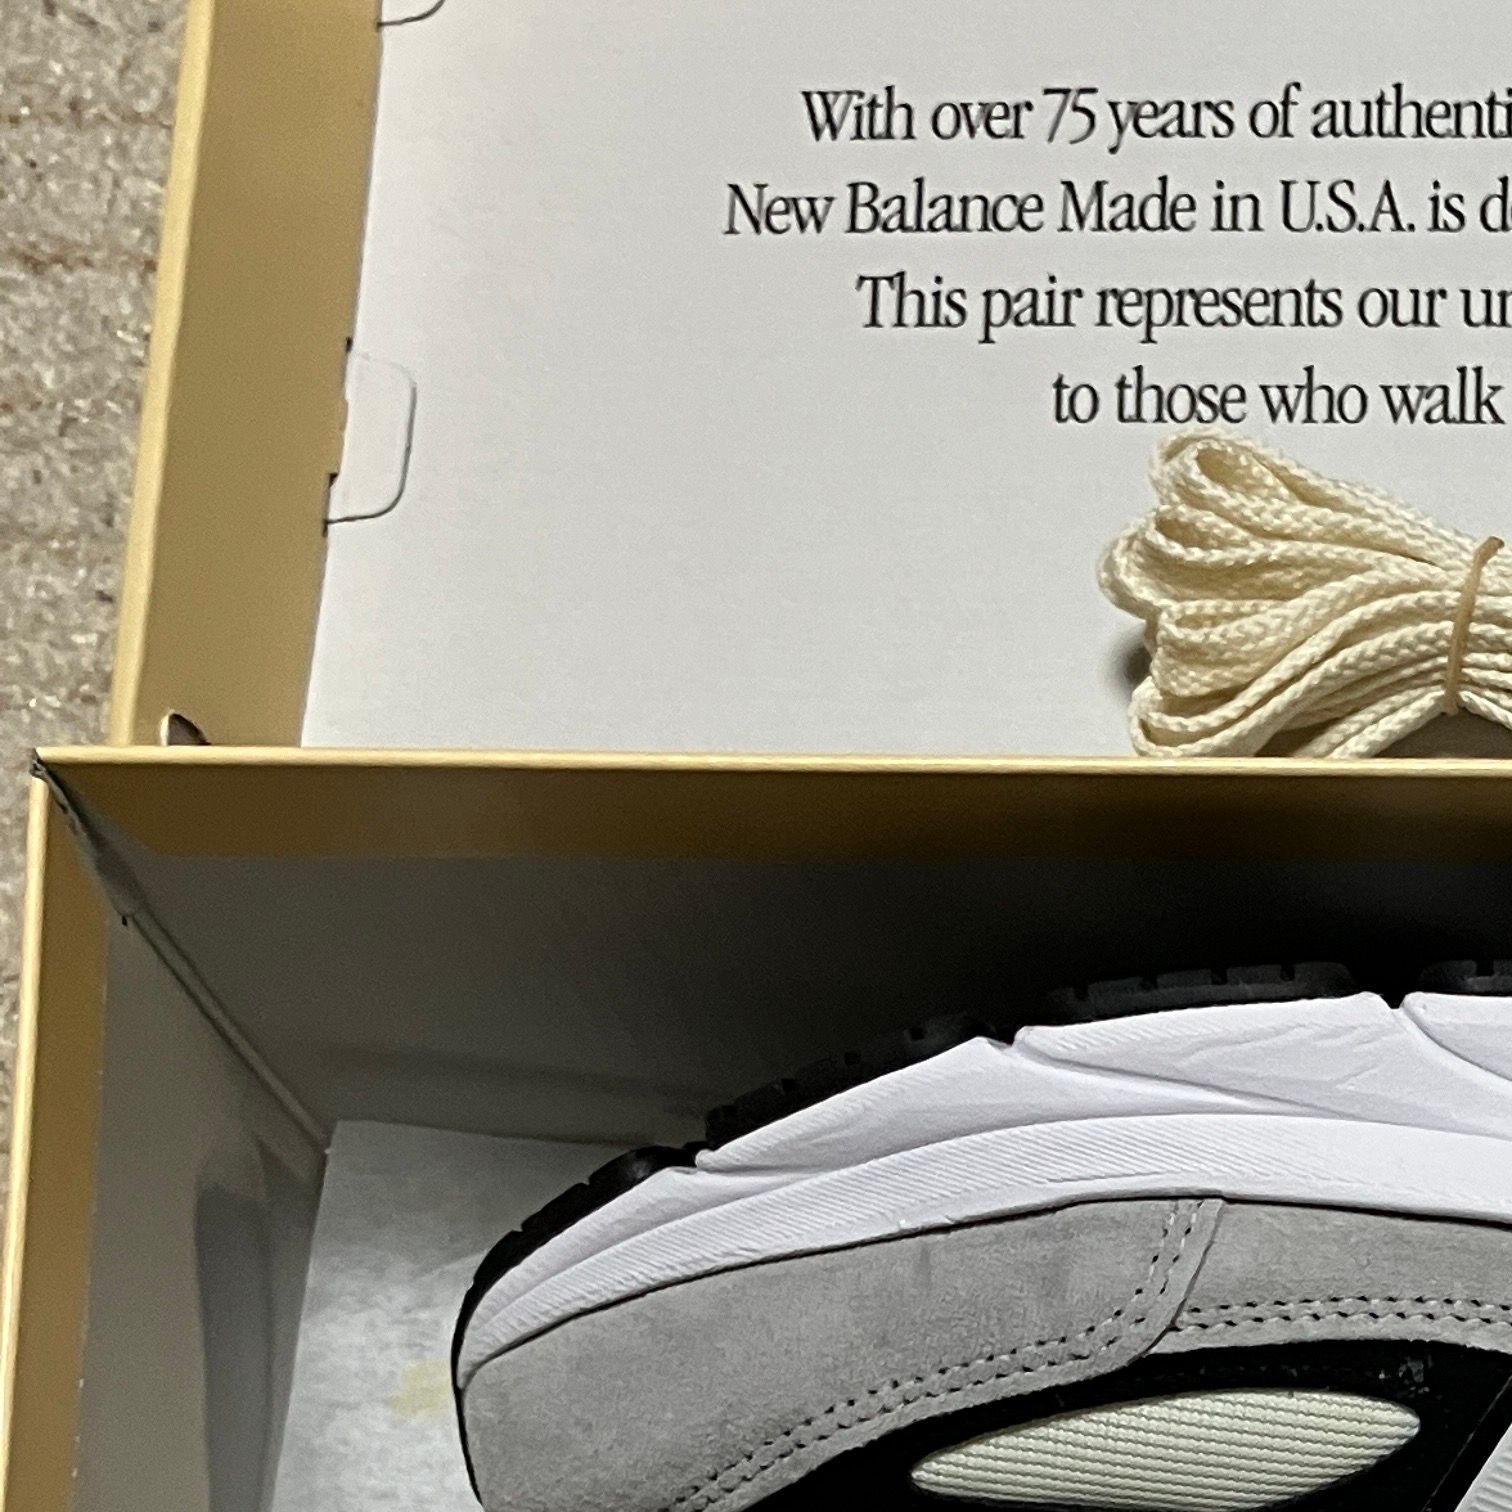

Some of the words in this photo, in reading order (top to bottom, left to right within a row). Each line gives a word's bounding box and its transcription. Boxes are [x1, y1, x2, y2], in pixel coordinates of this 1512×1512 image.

[801, 85, 917, 142] With
[930, 100, 1034, 140] over
[1042, 87, 1099, 145] 75
[1106, 100, 1235, 155] years
[1249, 81, 1302, 138] of
[723, 183, 837, 235] New
[844, 176, 1044, 234] Balance
[1057, 174, 1196, 232] Made
[1210, 180, 1264, 232] in
[1279, 179, 1416, 233] U.S.A.
[1427, 179, 1466, 233] is
[855, 269, 968, 328] This
[978, 272, 1084, 344] pair
[1094, 278, 1343, 344] represents
[1357, 287, 1448, 328] our
[1052, 373, 1100, 424] to
[1114, 365, 1247, 424] those
[1258, 365, 1368, 424] who
[1379, 365, 1506, 425] walk
